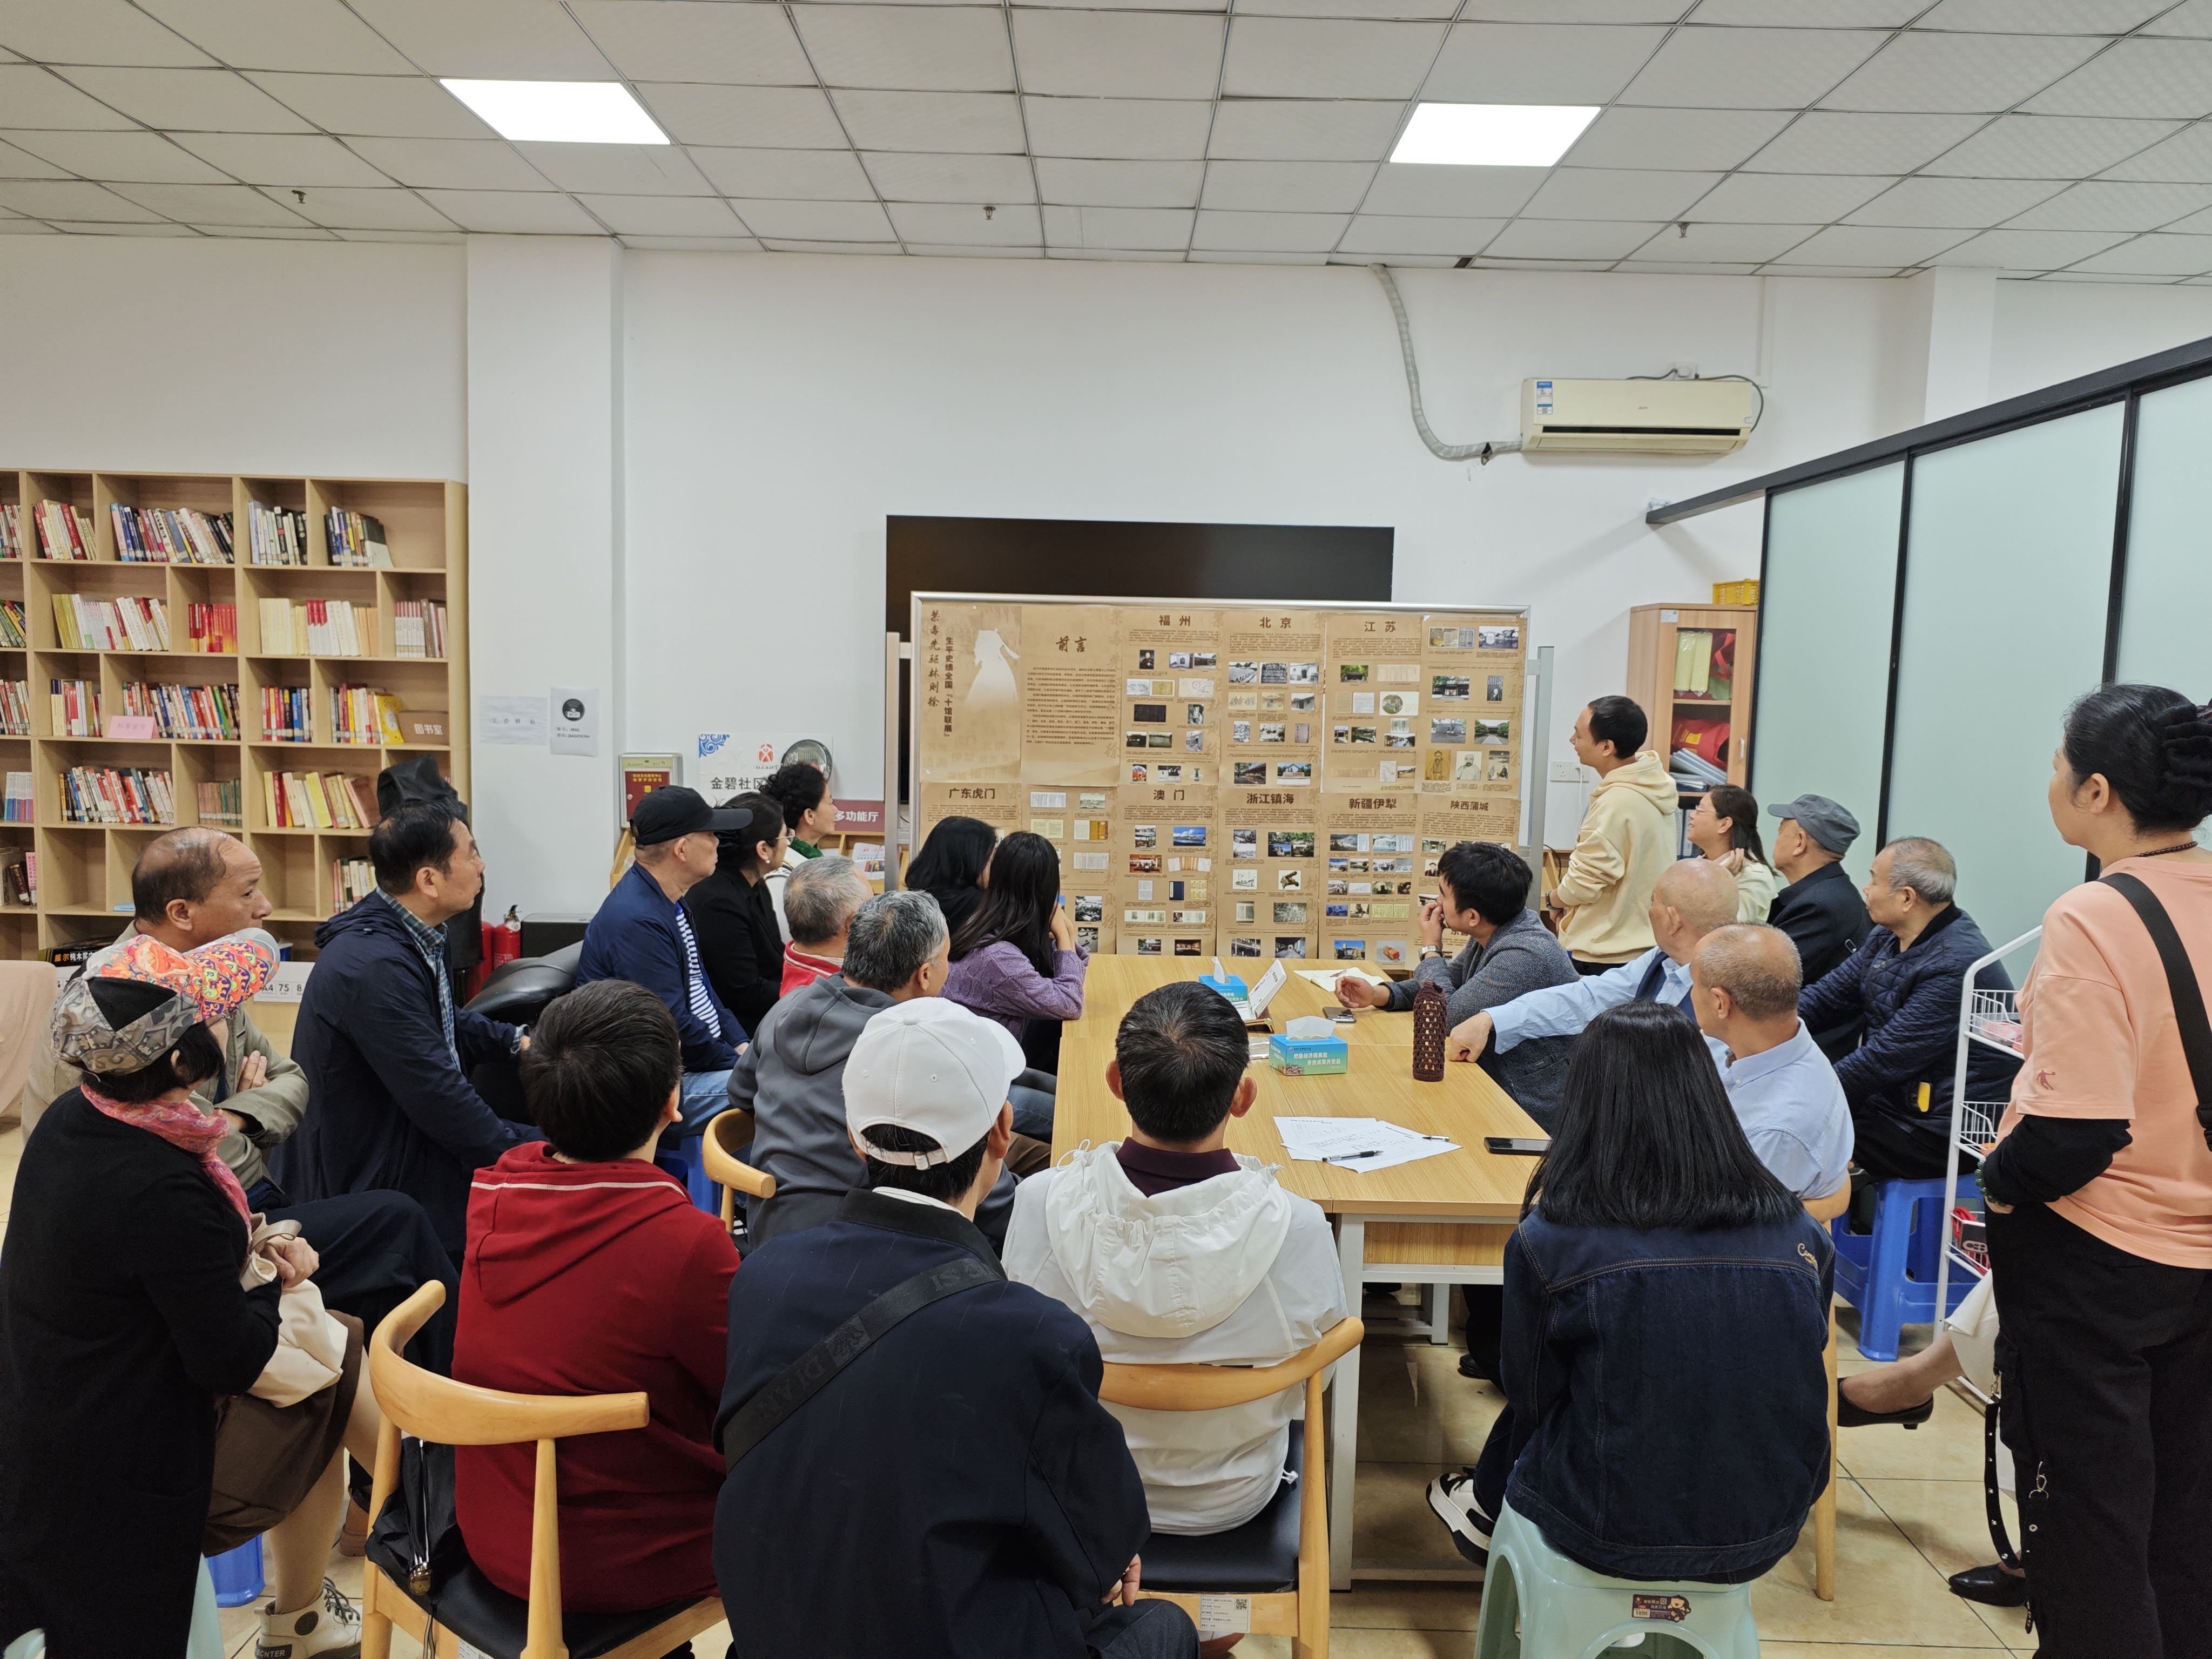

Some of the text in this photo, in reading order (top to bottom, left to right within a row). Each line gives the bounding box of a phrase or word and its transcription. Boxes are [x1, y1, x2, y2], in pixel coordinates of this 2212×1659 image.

[1158, 614, 1191, 627] 福州
[1259, 616, 1292, 629] 北京
[1364, 620, 1397, 633] 江苏
[1055, 635, 1088, 653] 前言
[927, 609, 941, 707] 禁毒先驱林则徐
[414, 723, 444, 735] 图书室
[711, 776, 767, 790] 金碧社区
[948, 787, 996, 800] 广东虎门
[1153, 788, 1185, 801] 澳门
[1246, 792, 1295, 805] 浙江镇海
[1348, 798, 1397, 810] 新疆伊犁
[1450, 800, 1489, 812] 陕西蒲城
[835, 811, 879, 822] 多功能厅
[278, 983, 289, 992] 75
[296, 984, 302, 992] 8
